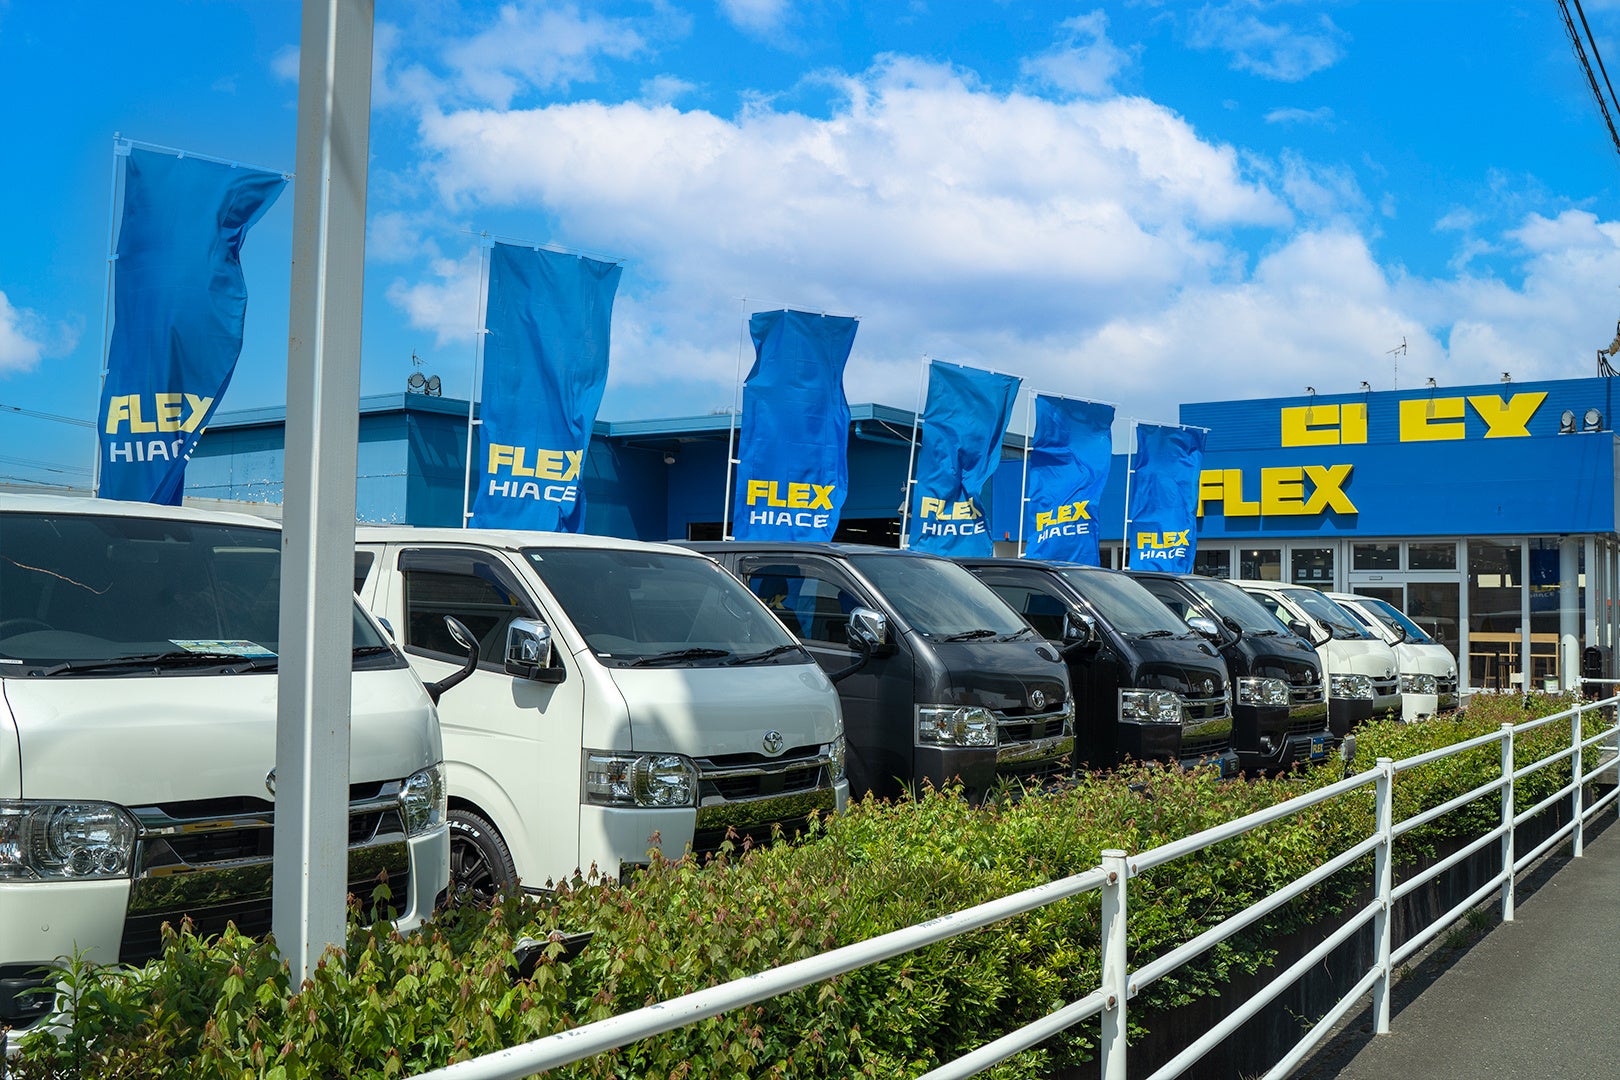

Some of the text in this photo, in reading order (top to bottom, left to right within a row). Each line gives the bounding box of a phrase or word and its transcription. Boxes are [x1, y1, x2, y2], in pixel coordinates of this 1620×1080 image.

[106, 393, 214, 434] FLEX
[110, 440, 190, 462] HIA
[488, 443, 584, 481] FLEX
[489, 480, 577, 502] HIACE
[746, 479, 836, 510] FLEX
[1196, 464, 1360, 517] FLEX
[750, 511, 830, 528] HIACE
[920, 496, 982, 521] FLEX
[1036, 500, 1091, 532] FLEX
[922, 520, 986, 536] HIACE
[1037, 523, 1090, 543] HIACE
[1137, 529, 1190, 549] FLEX
[1140, 548, 1187, 560] HIACE
